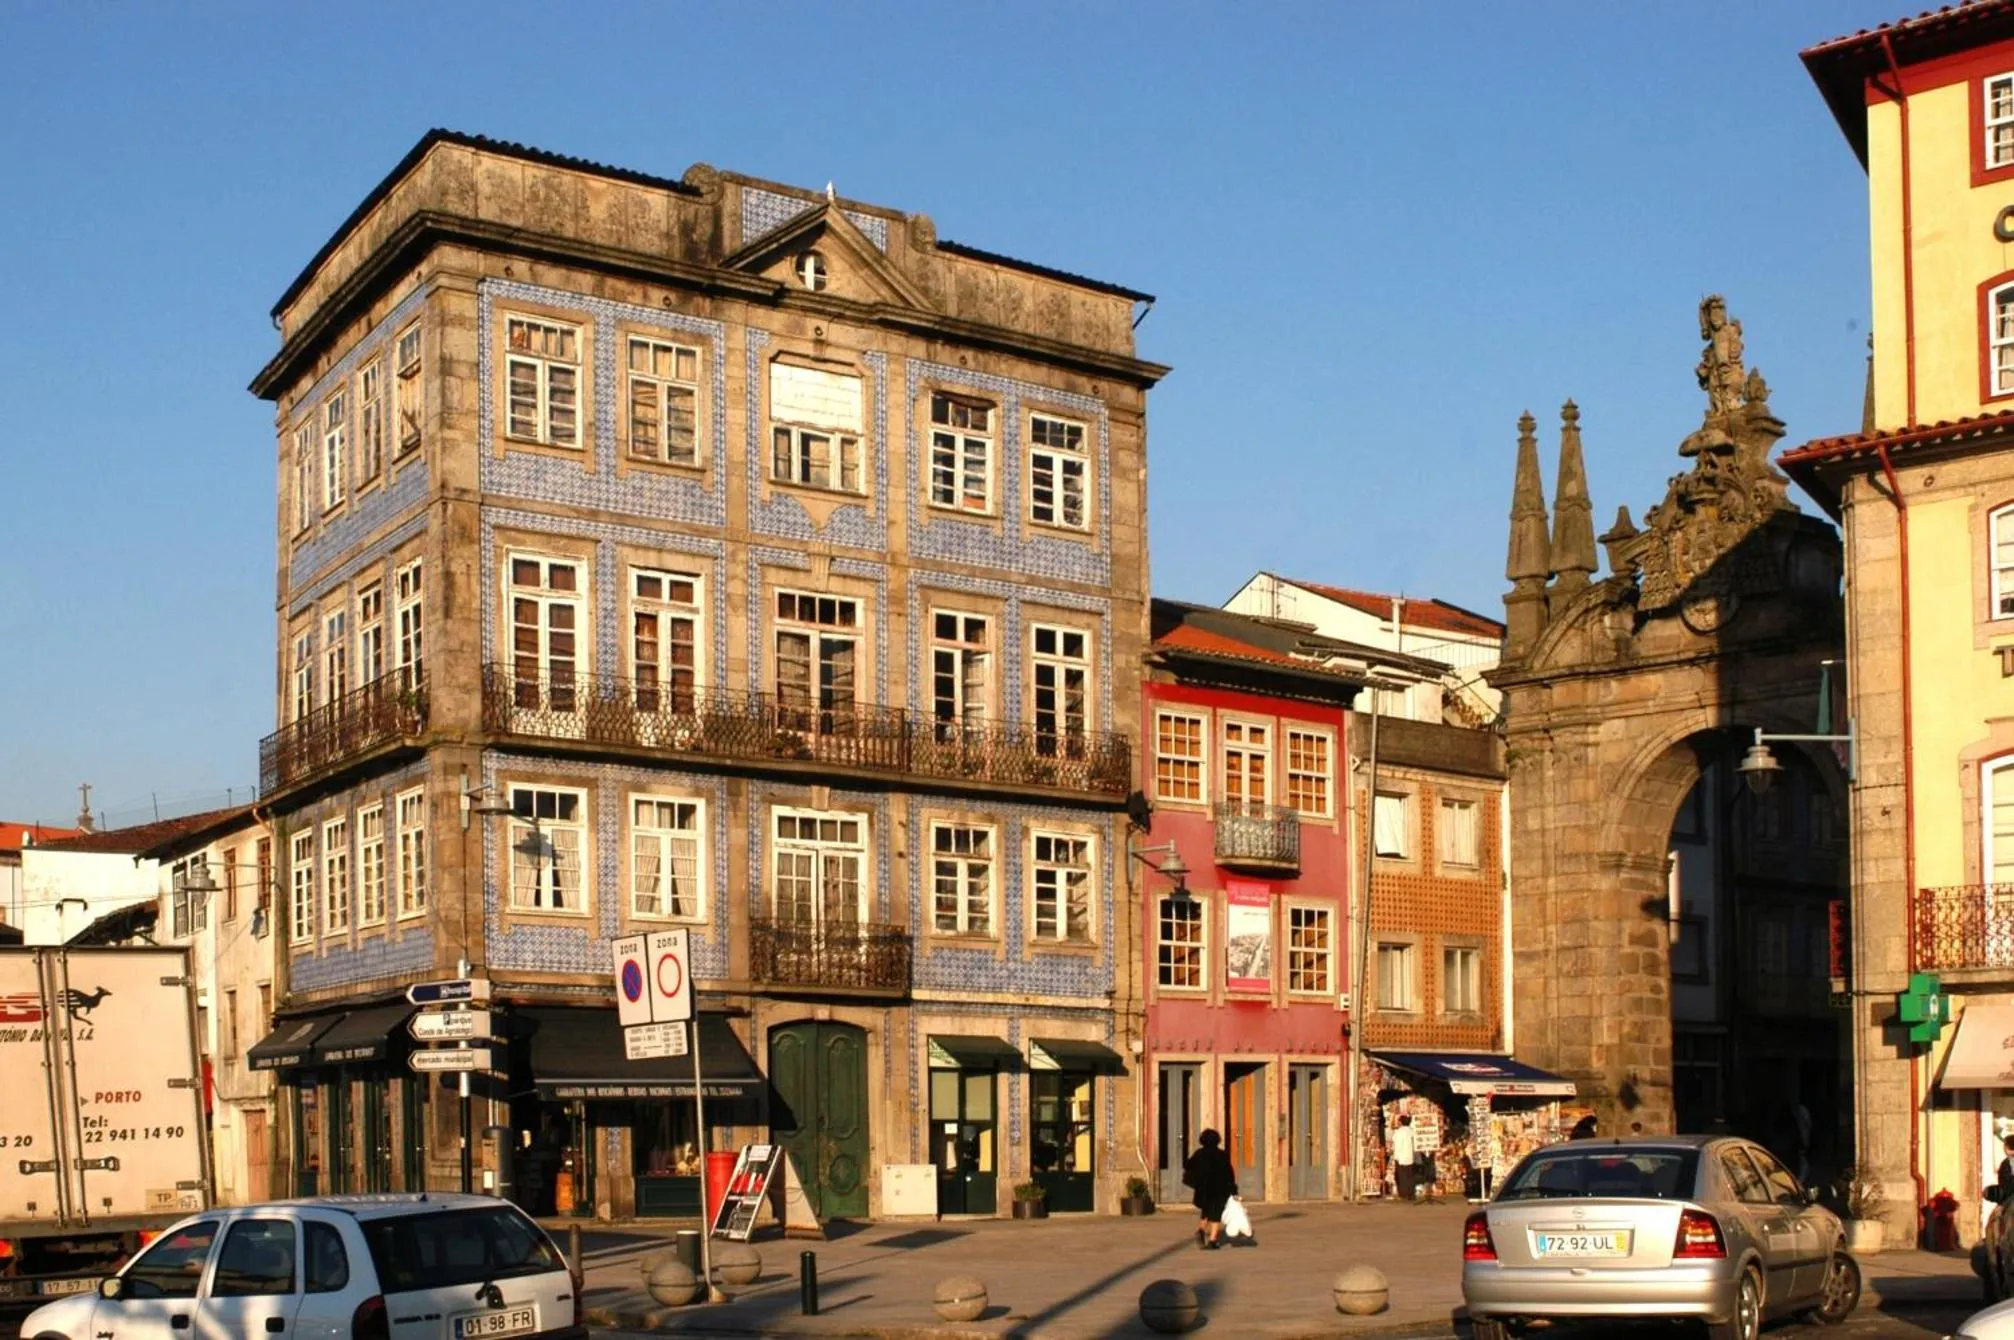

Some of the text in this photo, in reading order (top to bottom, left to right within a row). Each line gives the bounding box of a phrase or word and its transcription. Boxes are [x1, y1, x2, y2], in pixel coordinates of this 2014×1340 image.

[620, 943, 637, 955] zona
[656, 937, 678, 949] zona
[95, 1091, 142, 1104] PORTO
[83, 1116, 108, 1129] Tel:
[85, 1126, 184, 1143] 22 941 14 90
[14, 1135, 33, 1147] 20
